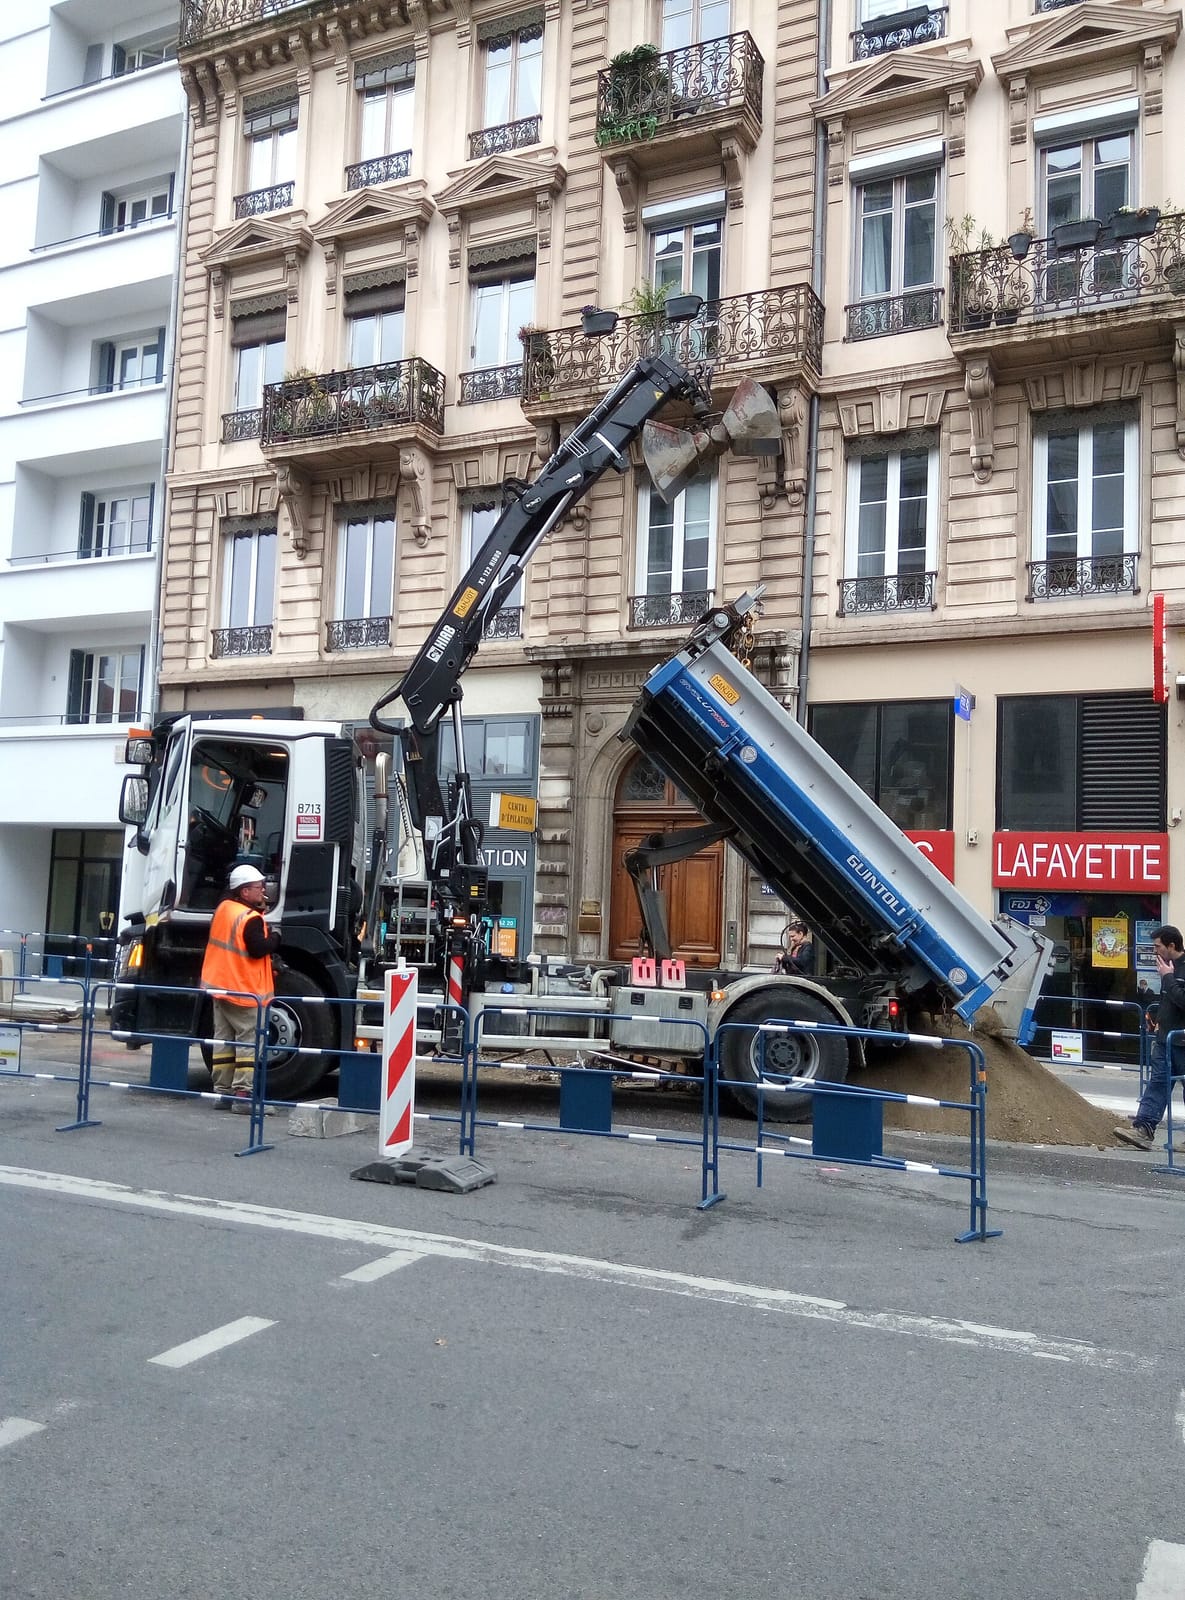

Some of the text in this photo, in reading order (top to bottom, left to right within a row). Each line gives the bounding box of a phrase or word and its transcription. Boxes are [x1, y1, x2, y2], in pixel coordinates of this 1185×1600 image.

[478, 576, 486, 586] XS
[482, 566, 493, 577] 122
[455, 590, 475, 615] MANJOT
[433, 624, 456, 651] HIAB
[711, 676, 737, 701] MANJOT
[297, 803, 321, 814] 8713
[507, 801, 528, 813] CENTRE
[997, 842, 1161, 880] LAFAYETTE
[846, 854, 907, 917] GUINTOLI
[1011, 900, 1031, 909] FDJ
